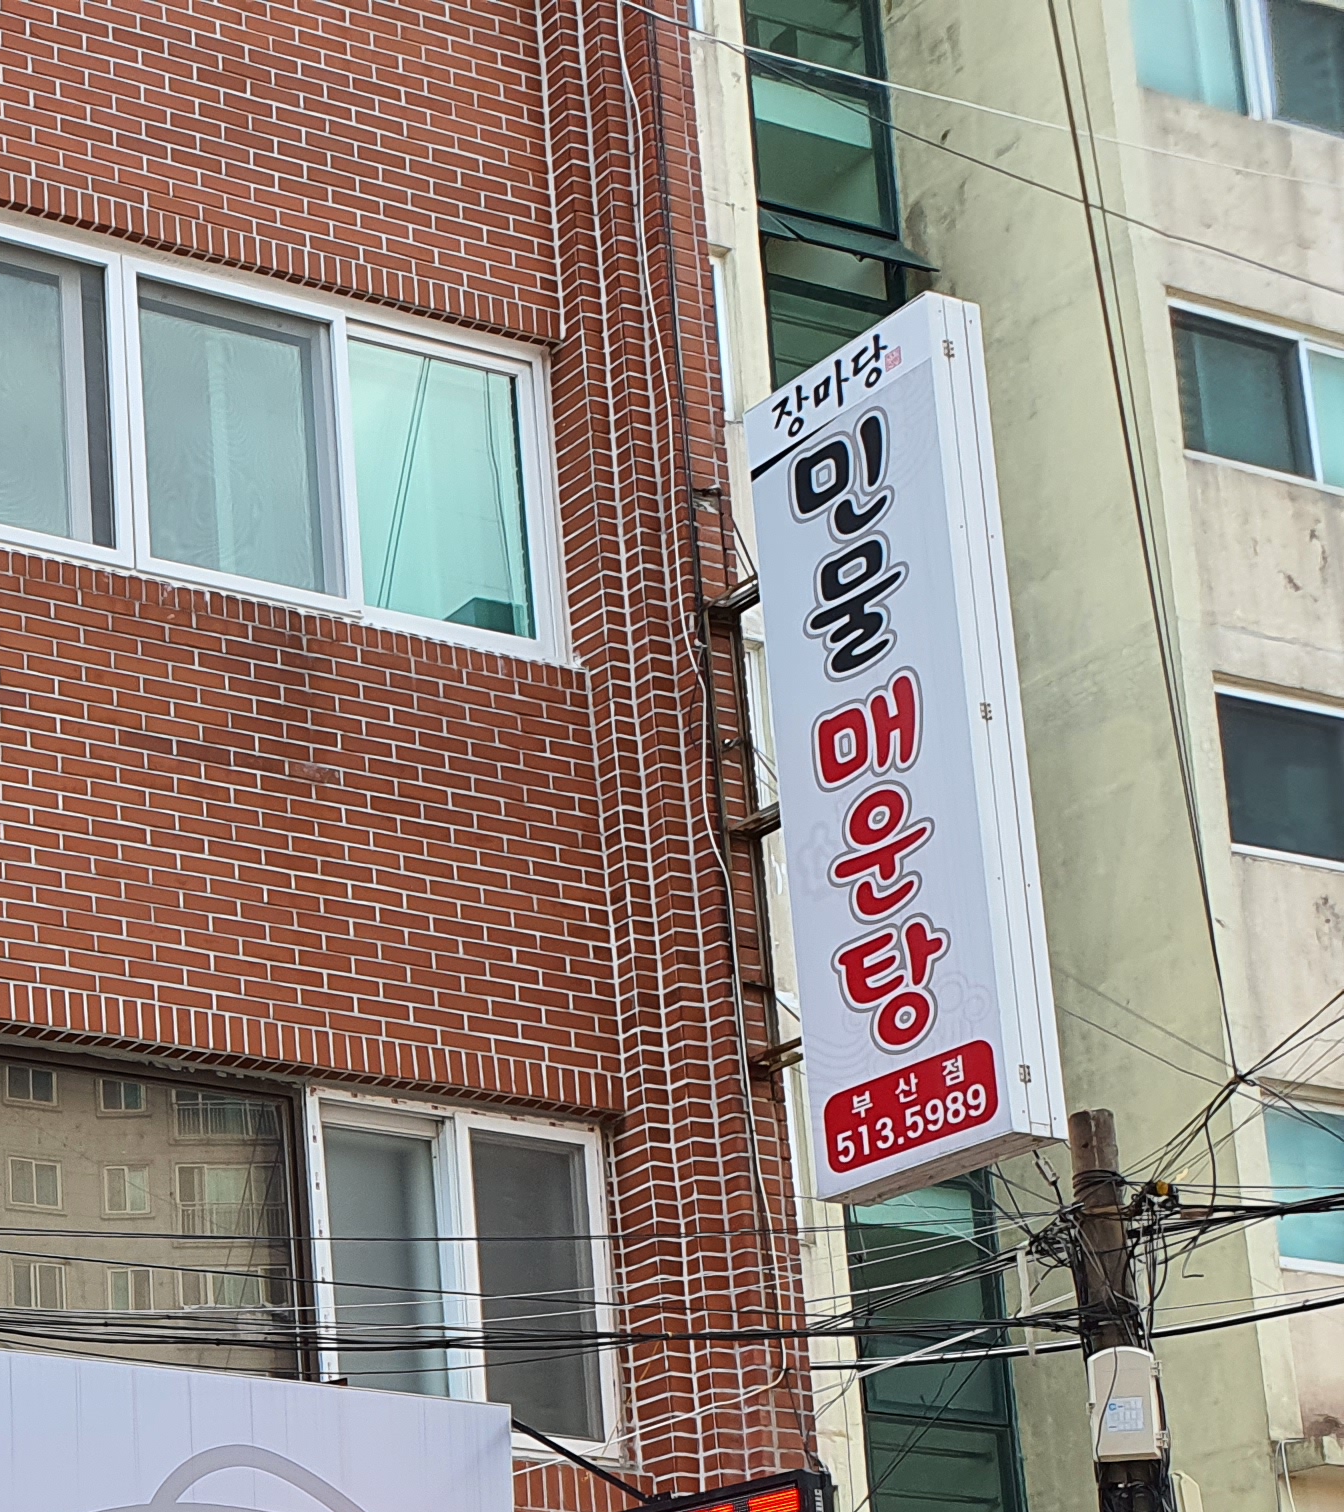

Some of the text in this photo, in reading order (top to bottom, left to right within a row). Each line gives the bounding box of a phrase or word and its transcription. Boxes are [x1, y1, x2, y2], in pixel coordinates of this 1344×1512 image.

[771, 334, 888, 437] 장마당
[793, 405, 950, 1055] 민물매운탕
[836, 1083, 987, 1163] 513.5989
